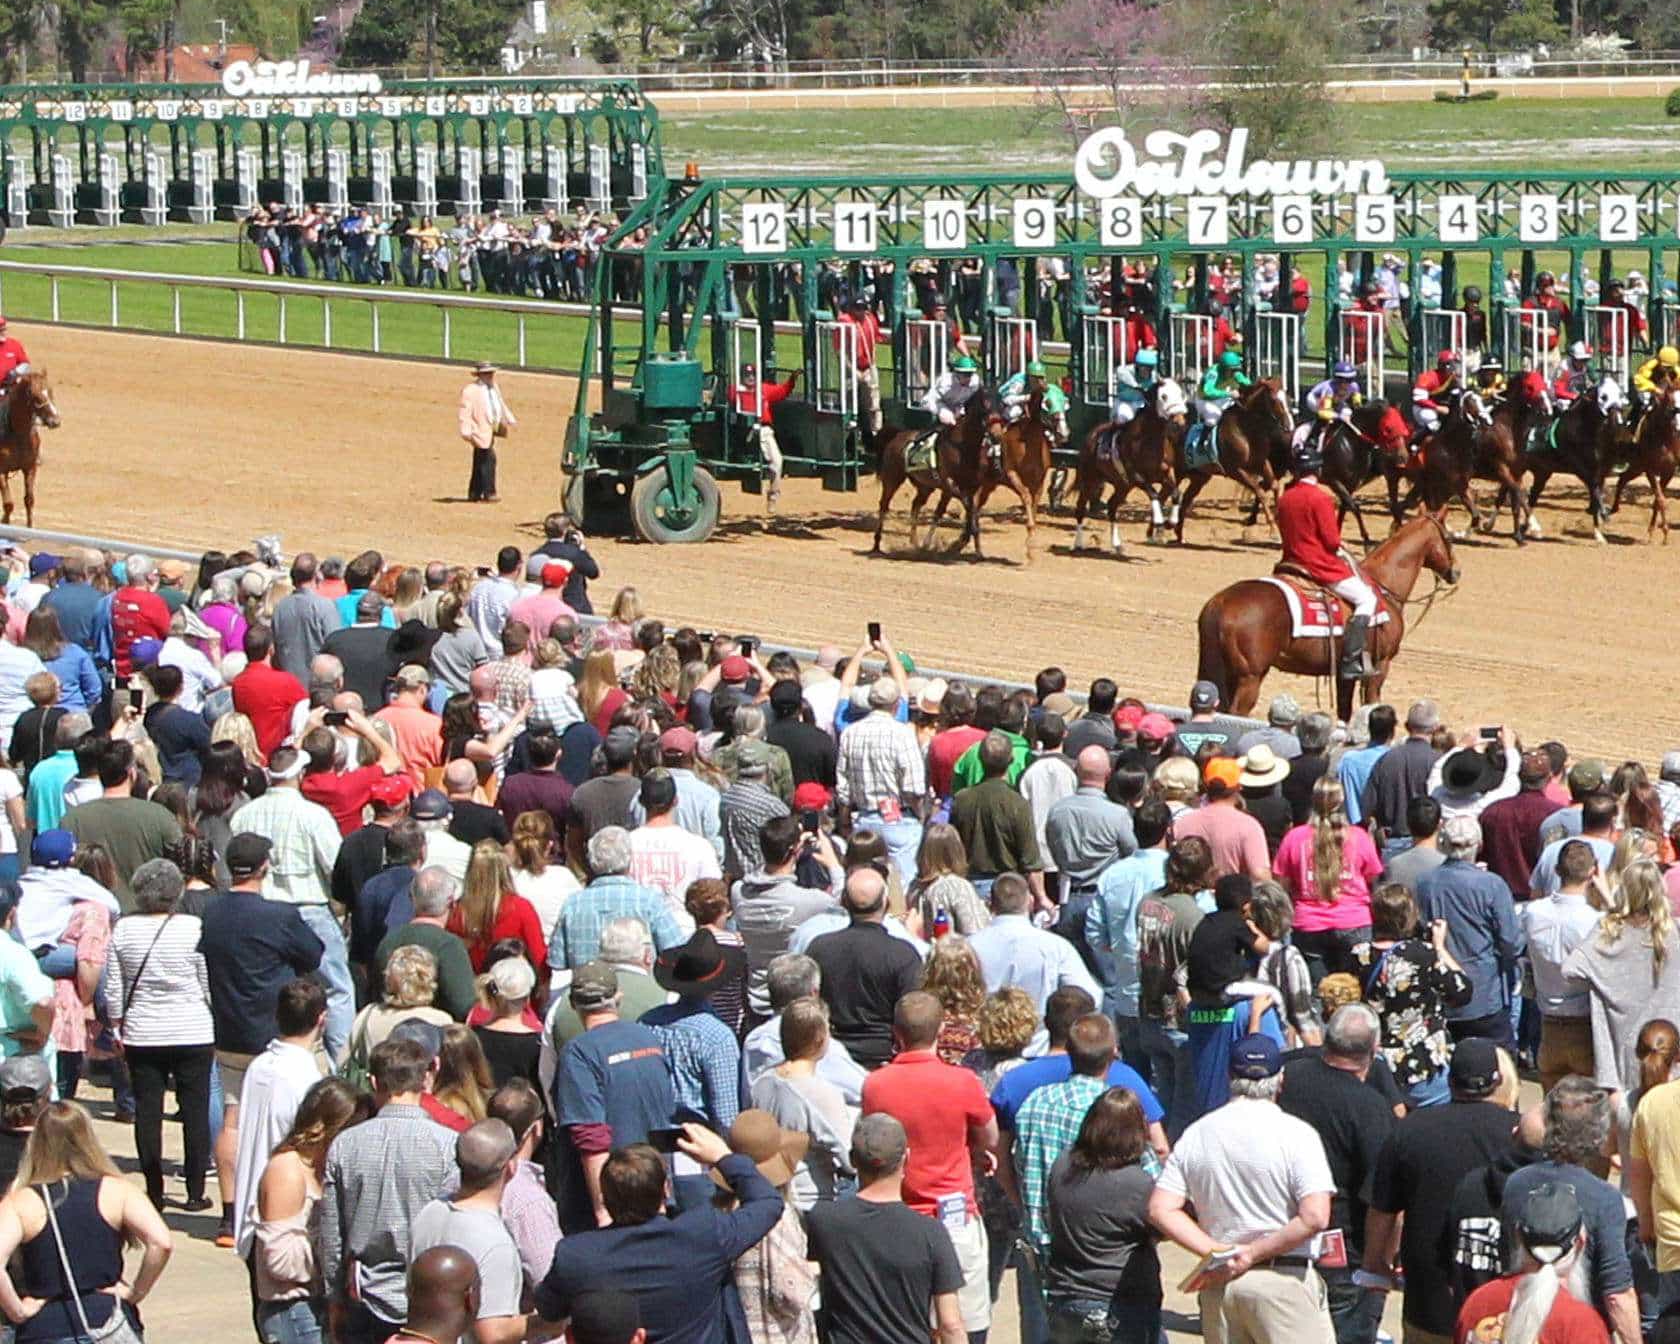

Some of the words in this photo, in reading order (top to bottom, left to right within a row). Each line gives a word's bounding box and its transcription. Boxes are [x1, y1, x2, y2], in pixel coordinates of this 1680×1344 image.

[222, 59, 382, 96] Oaklawn
[1074, 126, 1392, 198] Oaklawn
[749, 212, 780, 245] 12
[841, 211, 872, 244] 11
[932, 209, 960, 241] 10
[1023, 208, 1046, 239] 9
[1110, 206, 1133, 237] 8
[1197, 205, 1217, 237] 7
[1282, 204, 1304, 235] 6
[1364, 203, 1386, 234] 5
[1448, 204, 1468, 233] 4
[1530, 204, 1548, 233] 3
[1609, 204, 1628, 234] 2
